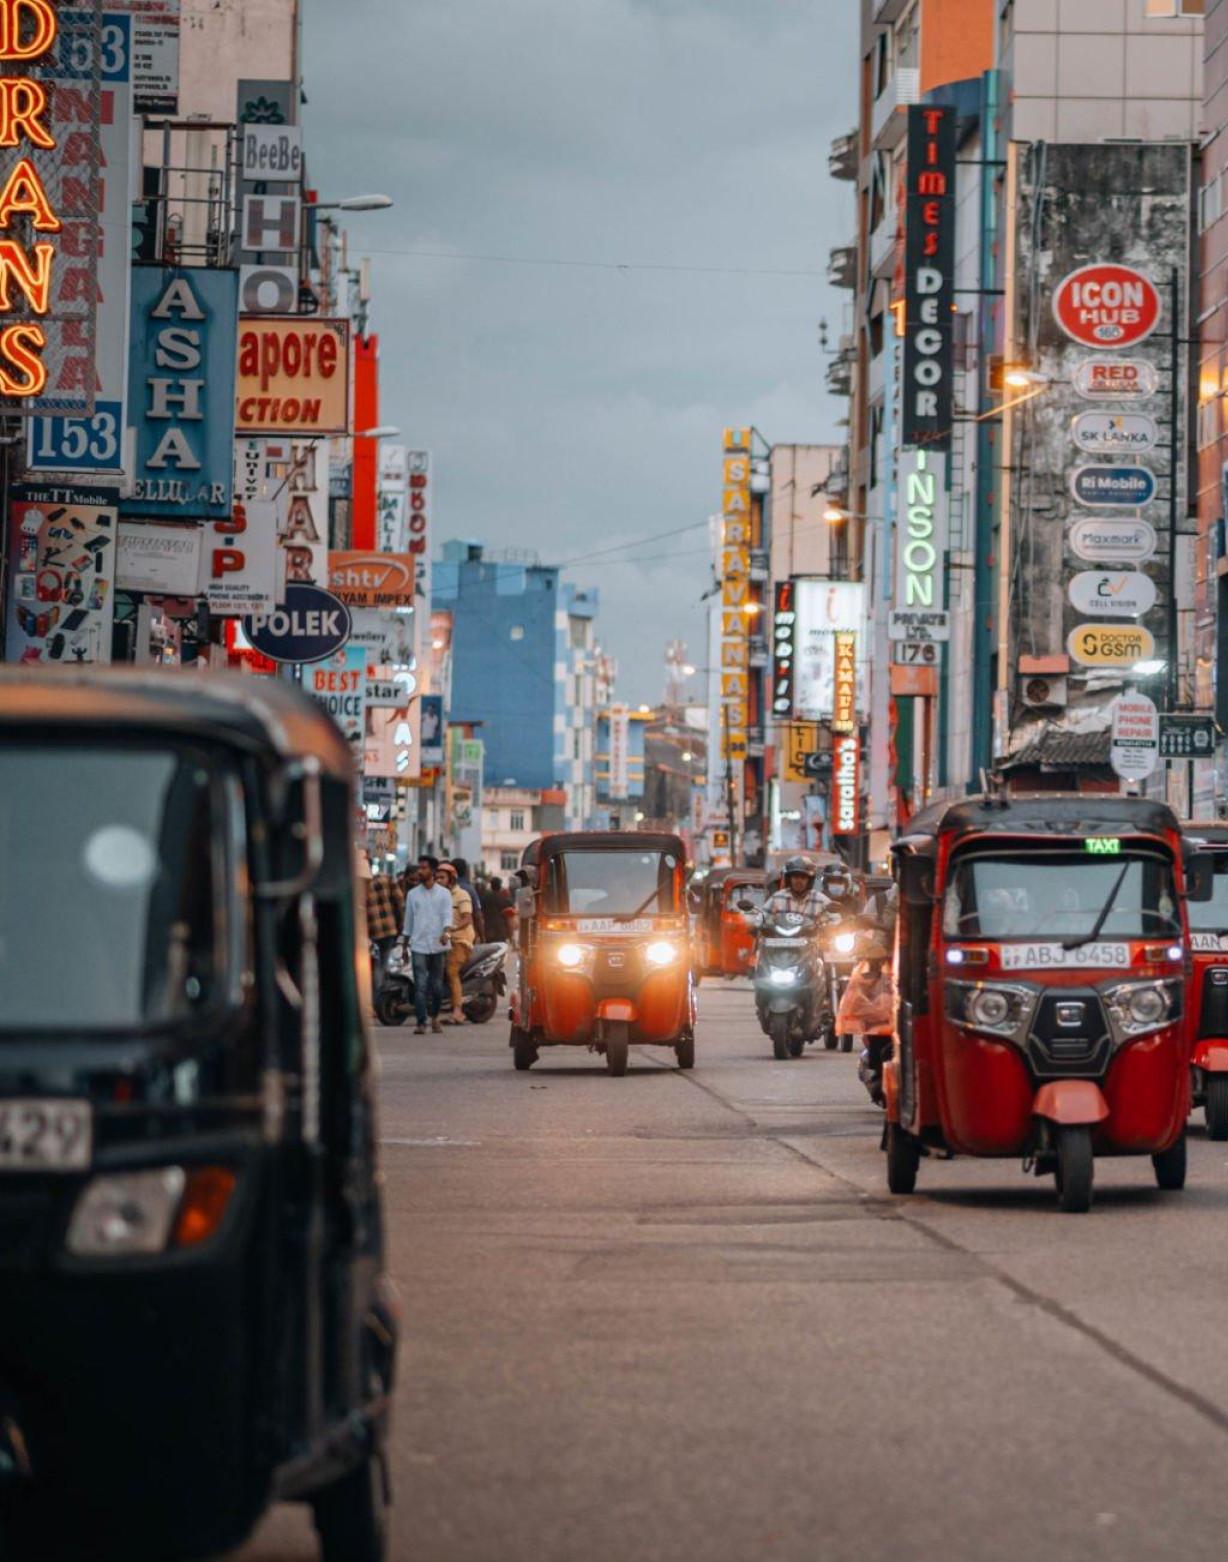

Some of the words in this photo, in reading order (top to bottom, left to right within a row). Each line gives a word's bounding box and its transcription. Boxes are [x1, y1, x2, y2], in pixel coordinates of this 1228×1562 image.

[918, 110, 946, 257] TIMES
[1071, 281, 1144, 308] ICON
[1080, 309, 1141, 325] HUB
[914, 268, 944, 417] DECOR
[239, 331, 338, 392] apore
[145, 277, 206, 470] ASHA
[1092, 365, 1138, 380] RED
[237, 396, 322, 423] CTION
[37, 411, 118, 461] 153
[1081, 431, 1099, 441] SK
[1103, 431, 1149, 442] LANKA
[1098, 477, 1147, 489] Mobile
[1082, 532, 1140, 545] Maxmark
[251, 610, 341, 636] POLEK
[893, 612, 946, 626] PRIVATE
[1100, 634, 1142, 644] DOCTOR
[902, 645, 936, 662] 176
[314, 669, 361, 692] BEST
[366, 681, 401, 698] star
[1118, 715, 1153, 725] PHONE
[1118, 728, 1153, 738] REPAIR
[1085, 838, 1120, 854] TAXI
[1025, 946, 1066, 964] ABJ
[1075, 945, 1127, 964] 6458
